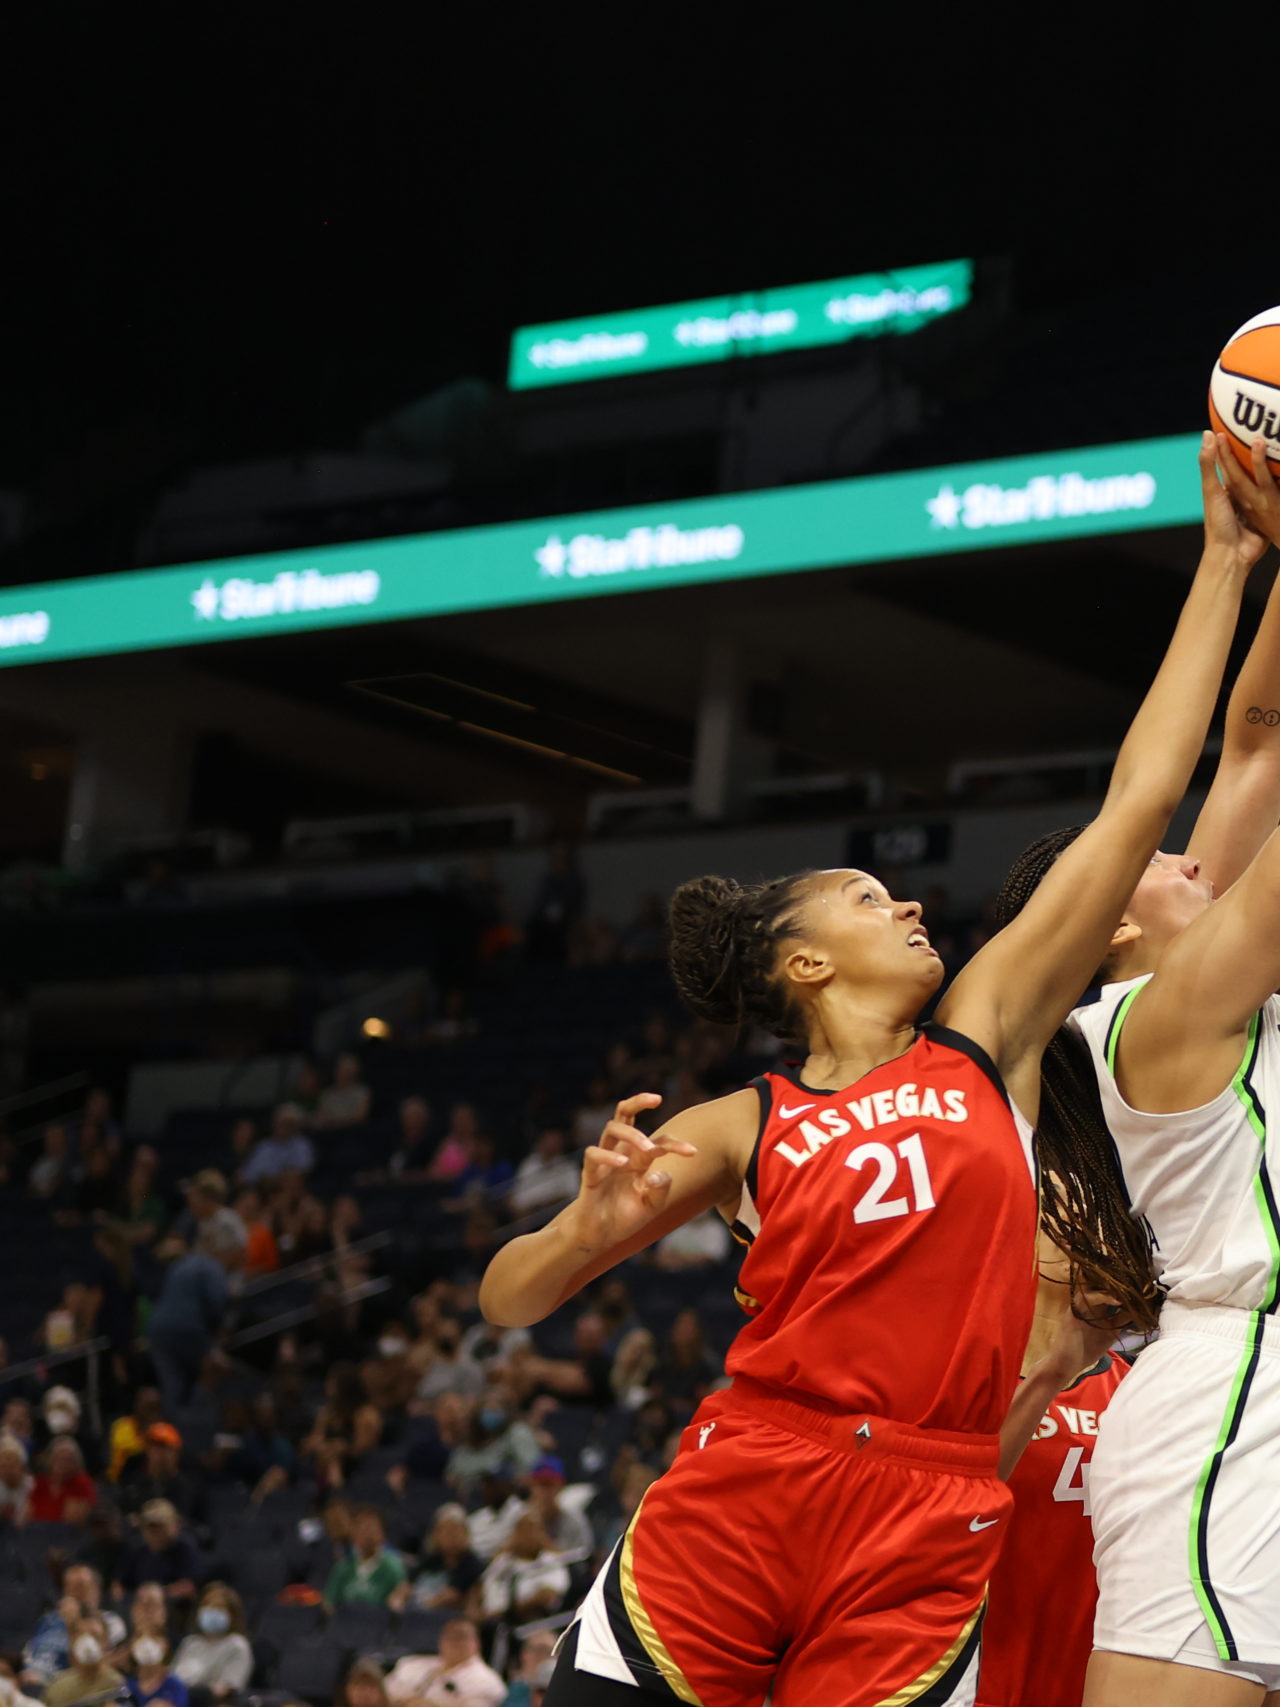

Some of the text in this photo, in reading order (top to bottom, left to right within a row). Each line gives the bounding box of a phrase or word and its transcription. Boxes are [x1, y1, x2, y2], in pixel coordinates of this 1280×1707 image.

[774, 1083, 969, 1168] LAS VEGAS
[844, 1133, 936, 1224] 21
[1056, 1405, 1100, 1436] VE
